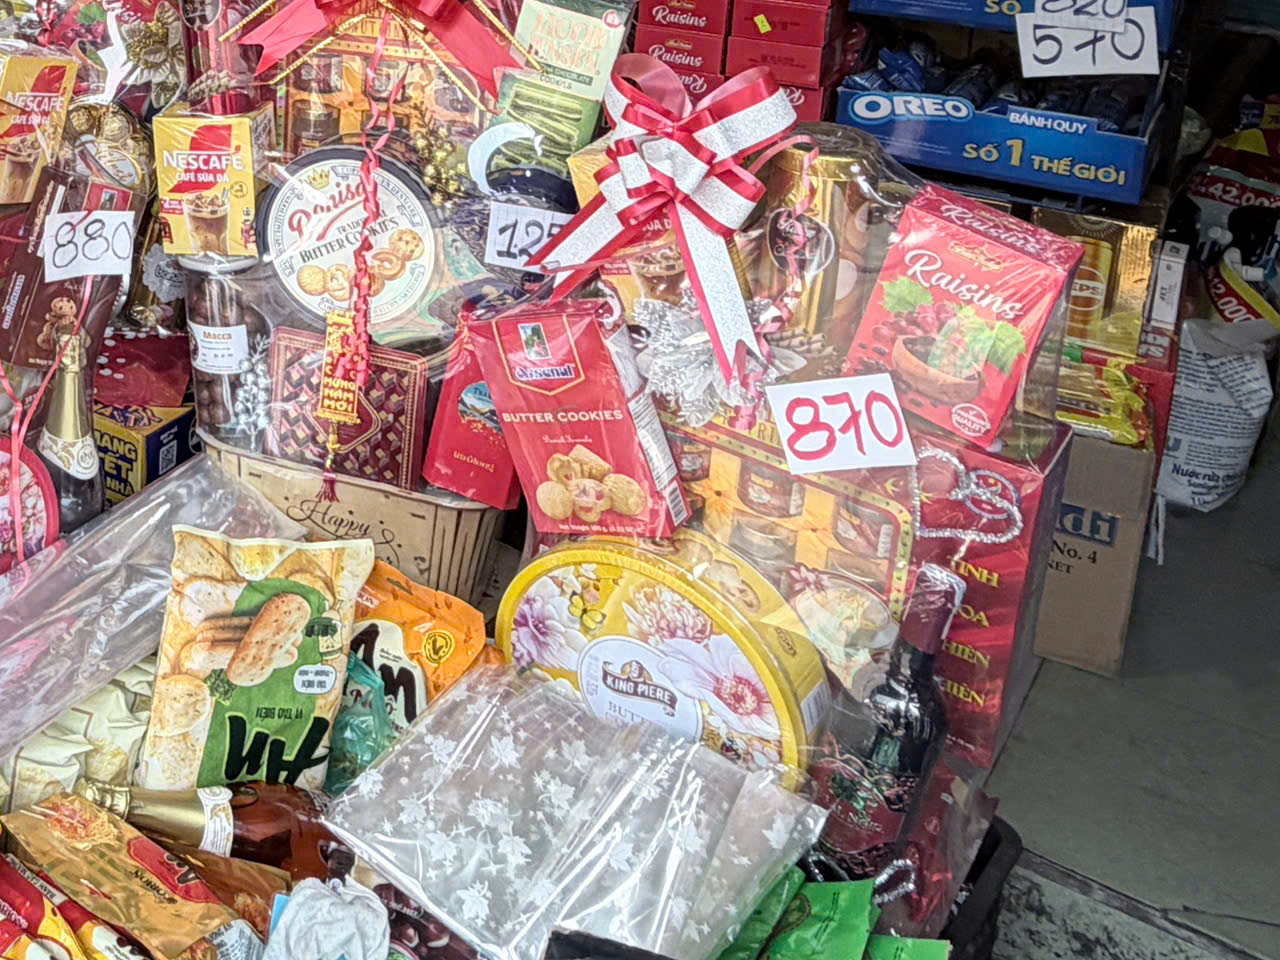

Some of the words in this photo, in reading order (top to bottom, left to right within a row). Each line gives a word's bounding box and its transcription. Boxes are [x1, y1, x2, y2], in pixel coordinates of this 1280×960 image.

[652, 6, 707, 28] Raisins
[648, 45, 703, 67] Raisins
[853, 95, 972, 121] OREO
[1051, 117, 1088, 136] QUY
[963, 141, 998, 163] SỐ
[1007, 138, 1025, 167] 1
[940, 200, 1044, 252] Raisins
[52, 219, 132, 269] 880
[299, 236, 347, 264] BUTTER
[903, 248, 1025, 322] Raisins
[501, 410, 555, 424] BUTTER
[556, 408, 624, 423] COOKIES
[784, 388, 904, 461] 870
[1051, 539, 1083, 561] No.
[1087, 550, 1099, 565] 4
[957, 605, 991, 628] OA
[605, 672, 634, 695] KING
[634, 679, 674, 703] PIERE
